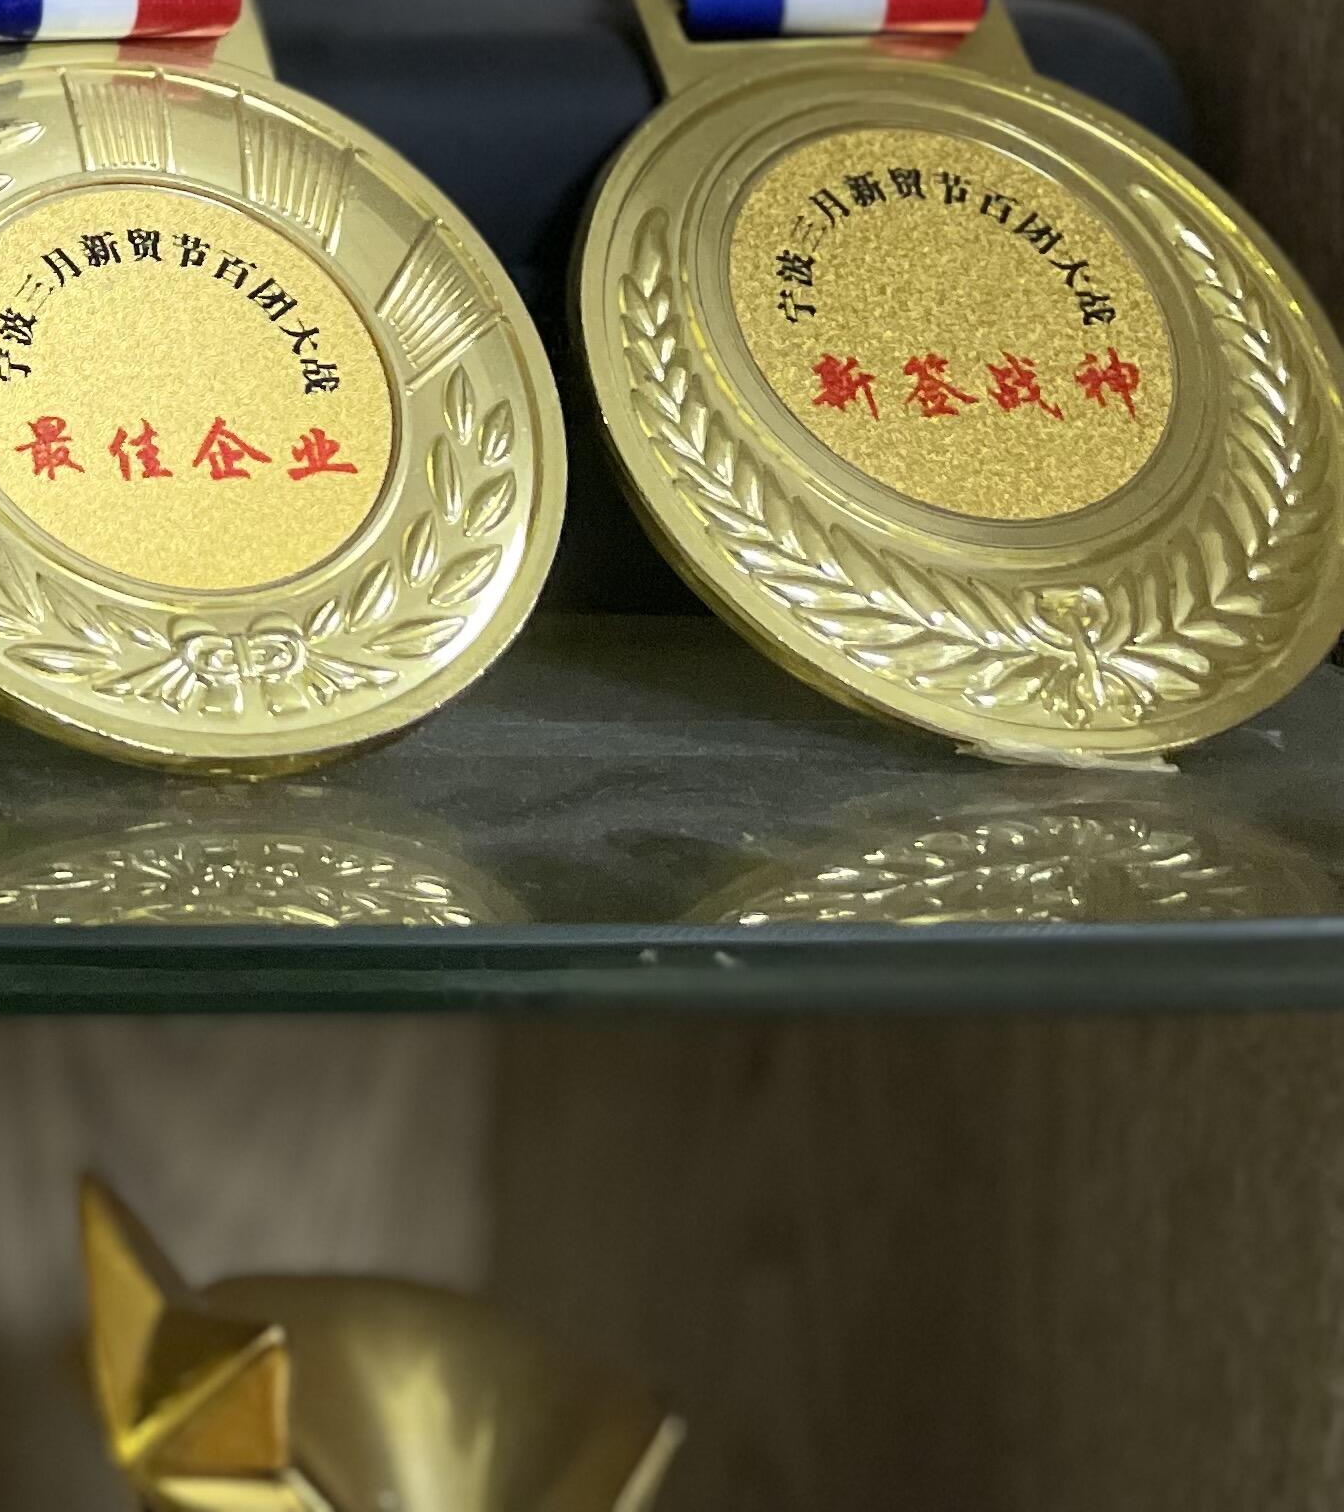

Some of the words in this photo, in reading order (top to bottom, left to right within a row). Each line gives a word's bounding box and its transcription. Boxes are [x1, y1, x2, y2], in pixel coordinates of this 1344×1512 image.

[777, 168, 1115, 325] 宁波三月新贸节百团大战
[812, 347, 1141, 420] 新签战神
[16, 416, 358, 480] 最佳企业
